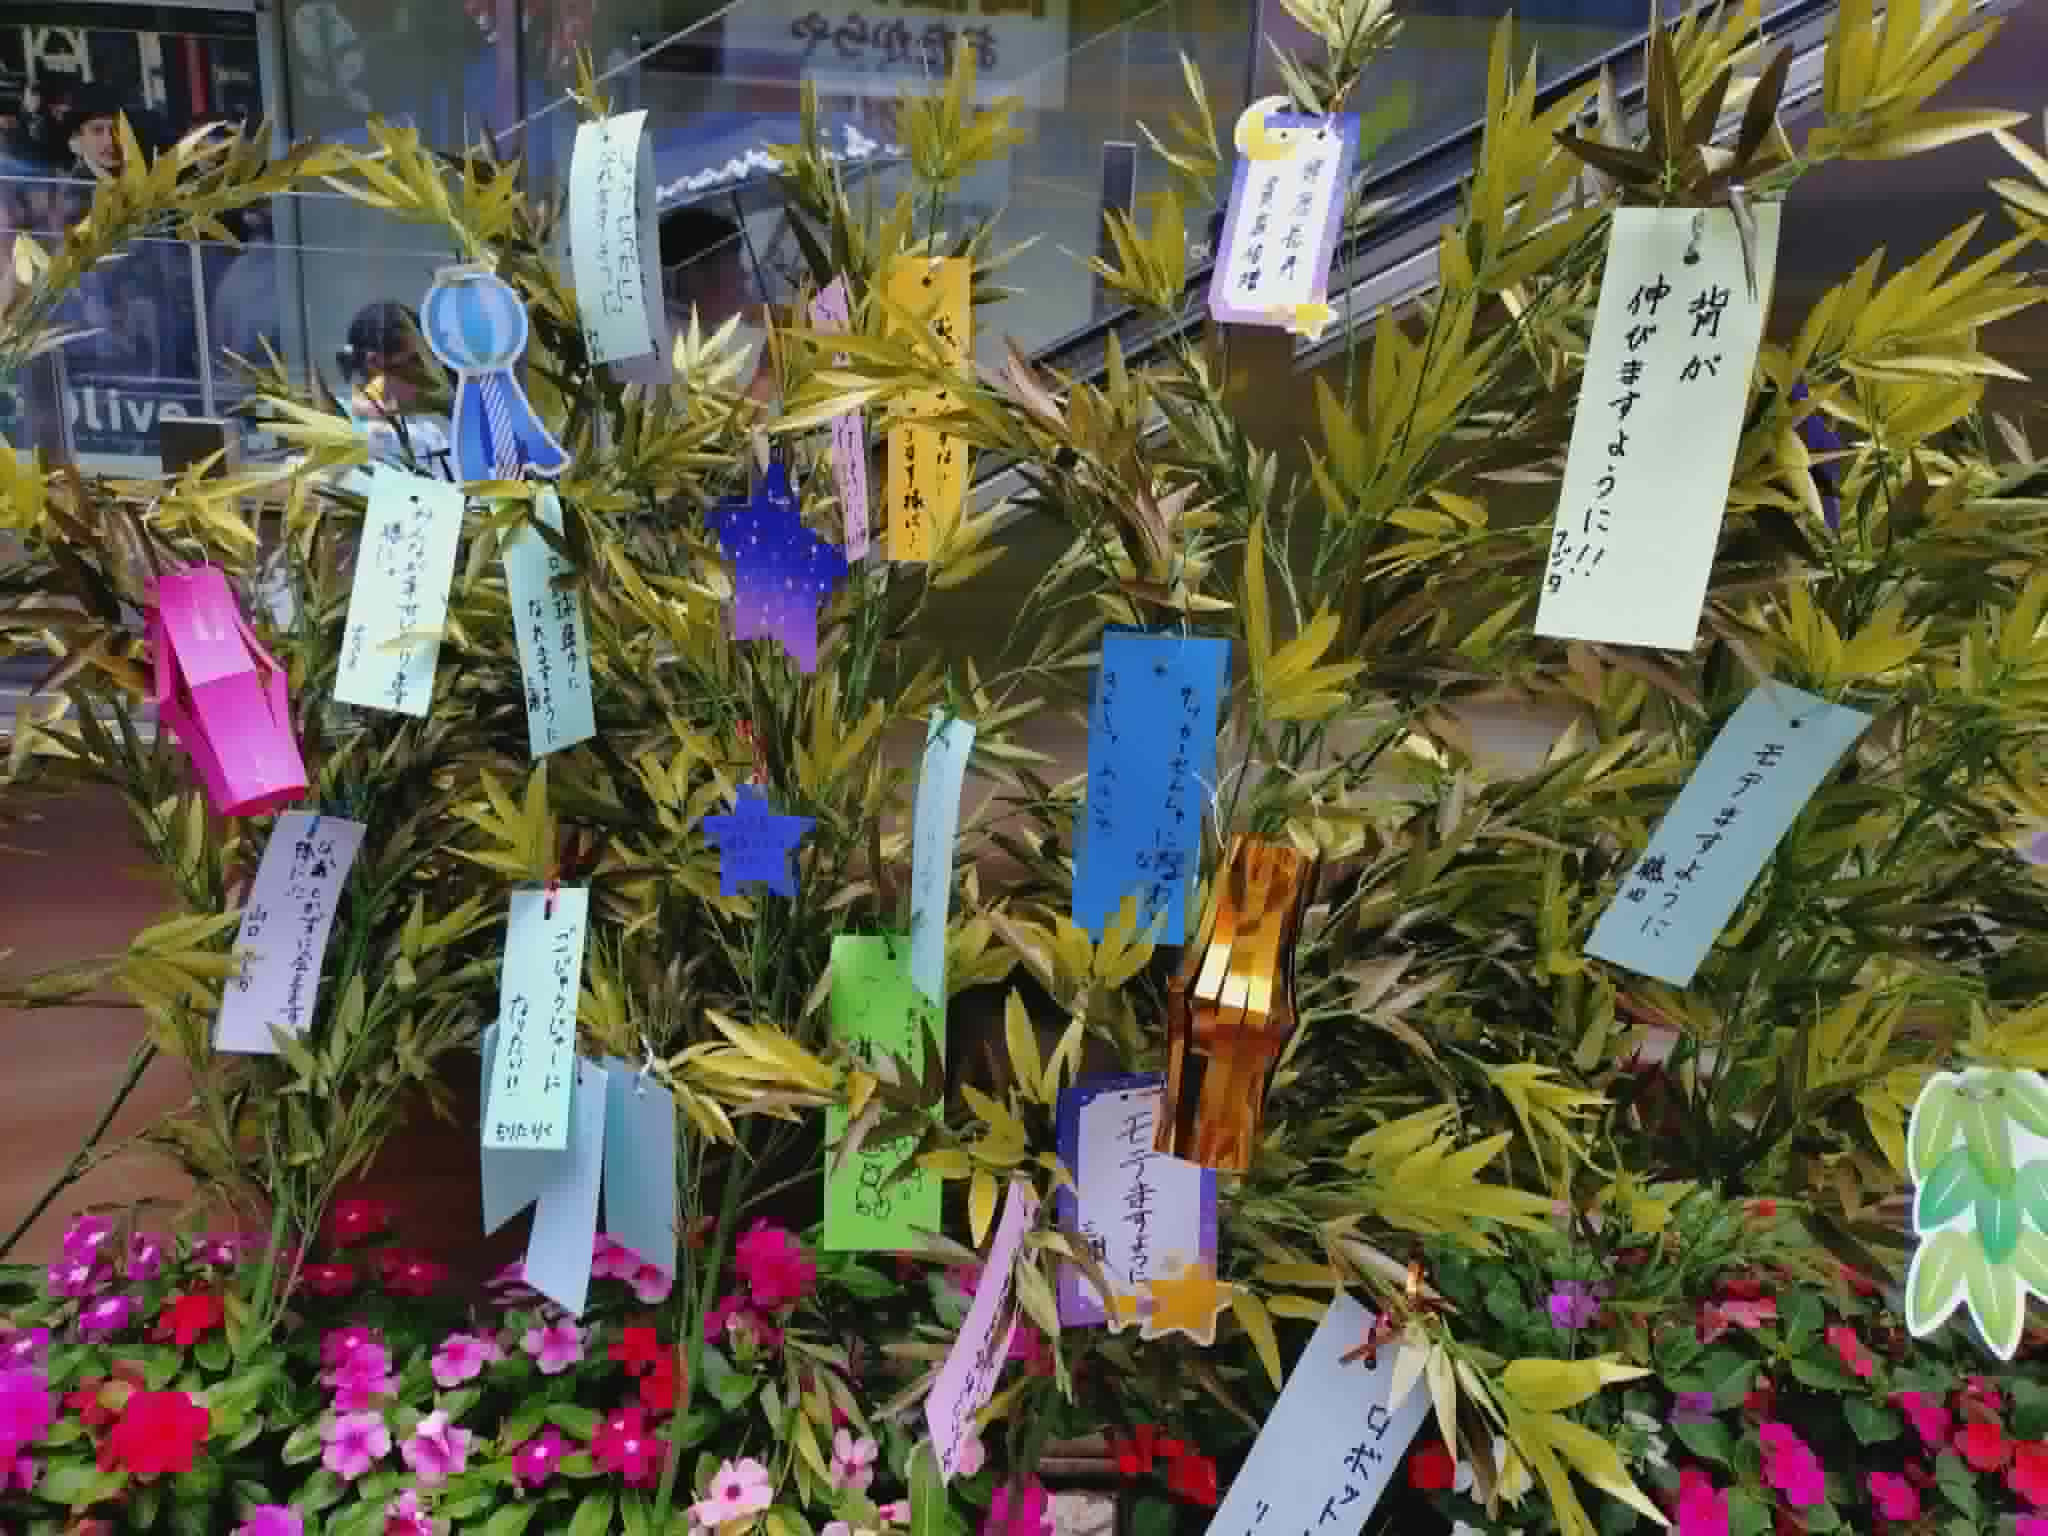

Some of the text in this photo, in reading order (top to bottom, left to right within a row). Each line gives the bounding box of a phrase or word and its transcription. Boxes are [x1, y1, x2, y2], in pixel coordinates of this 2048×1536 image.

[1680, 284, 1731, 383] 背が
[1640, 743, 1784, 938] モテますように
[1303, 1403, 1391, 1536] ロボット
